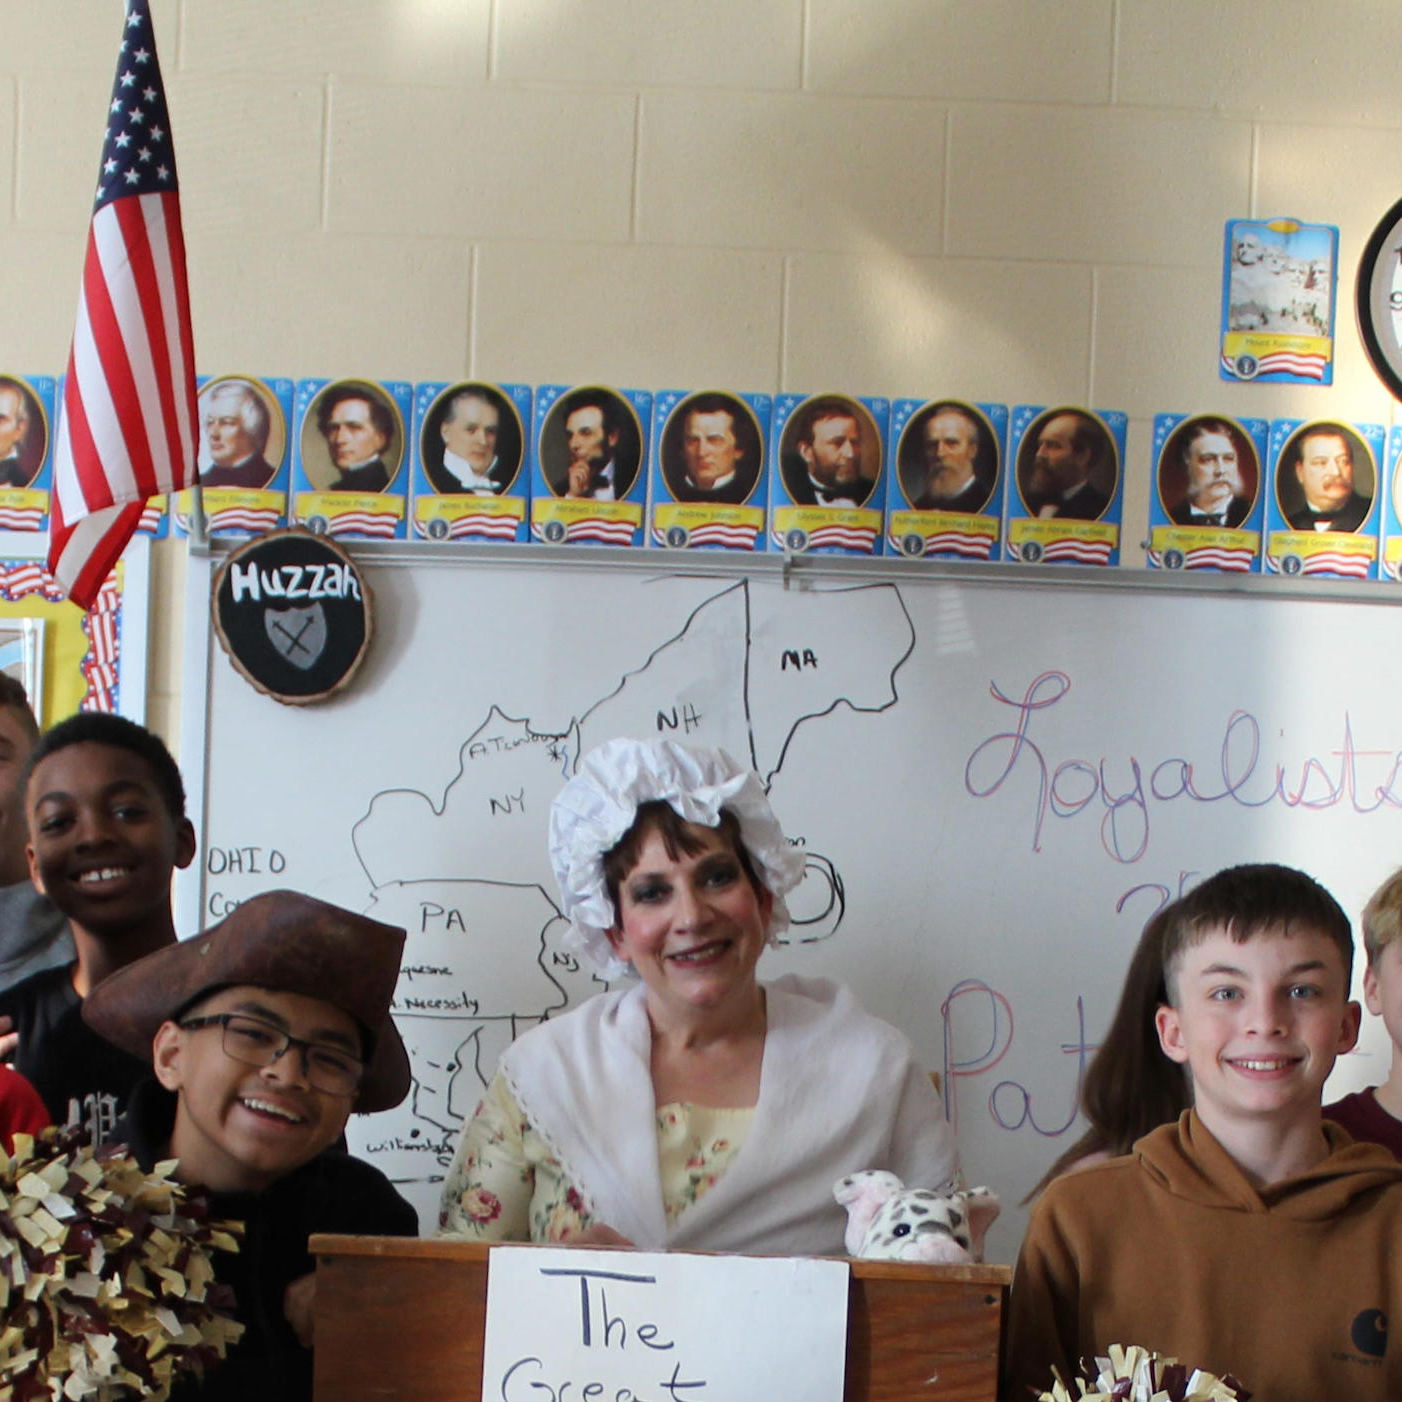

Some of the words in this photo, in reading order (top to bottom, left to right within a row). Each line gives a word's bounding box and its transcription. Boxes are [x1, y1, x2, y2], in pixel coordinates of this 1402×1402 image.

[230, 562, 362, 603] Huzzah
[780, 648, 819, 673] MA
[655, 704, 703, 733] NH
[489, 786, 525, 816] NY
[207, 847, 287, 875] OHIO
[420, 901, 466, 933] PA
[540, 1267, 675, 1350] The
